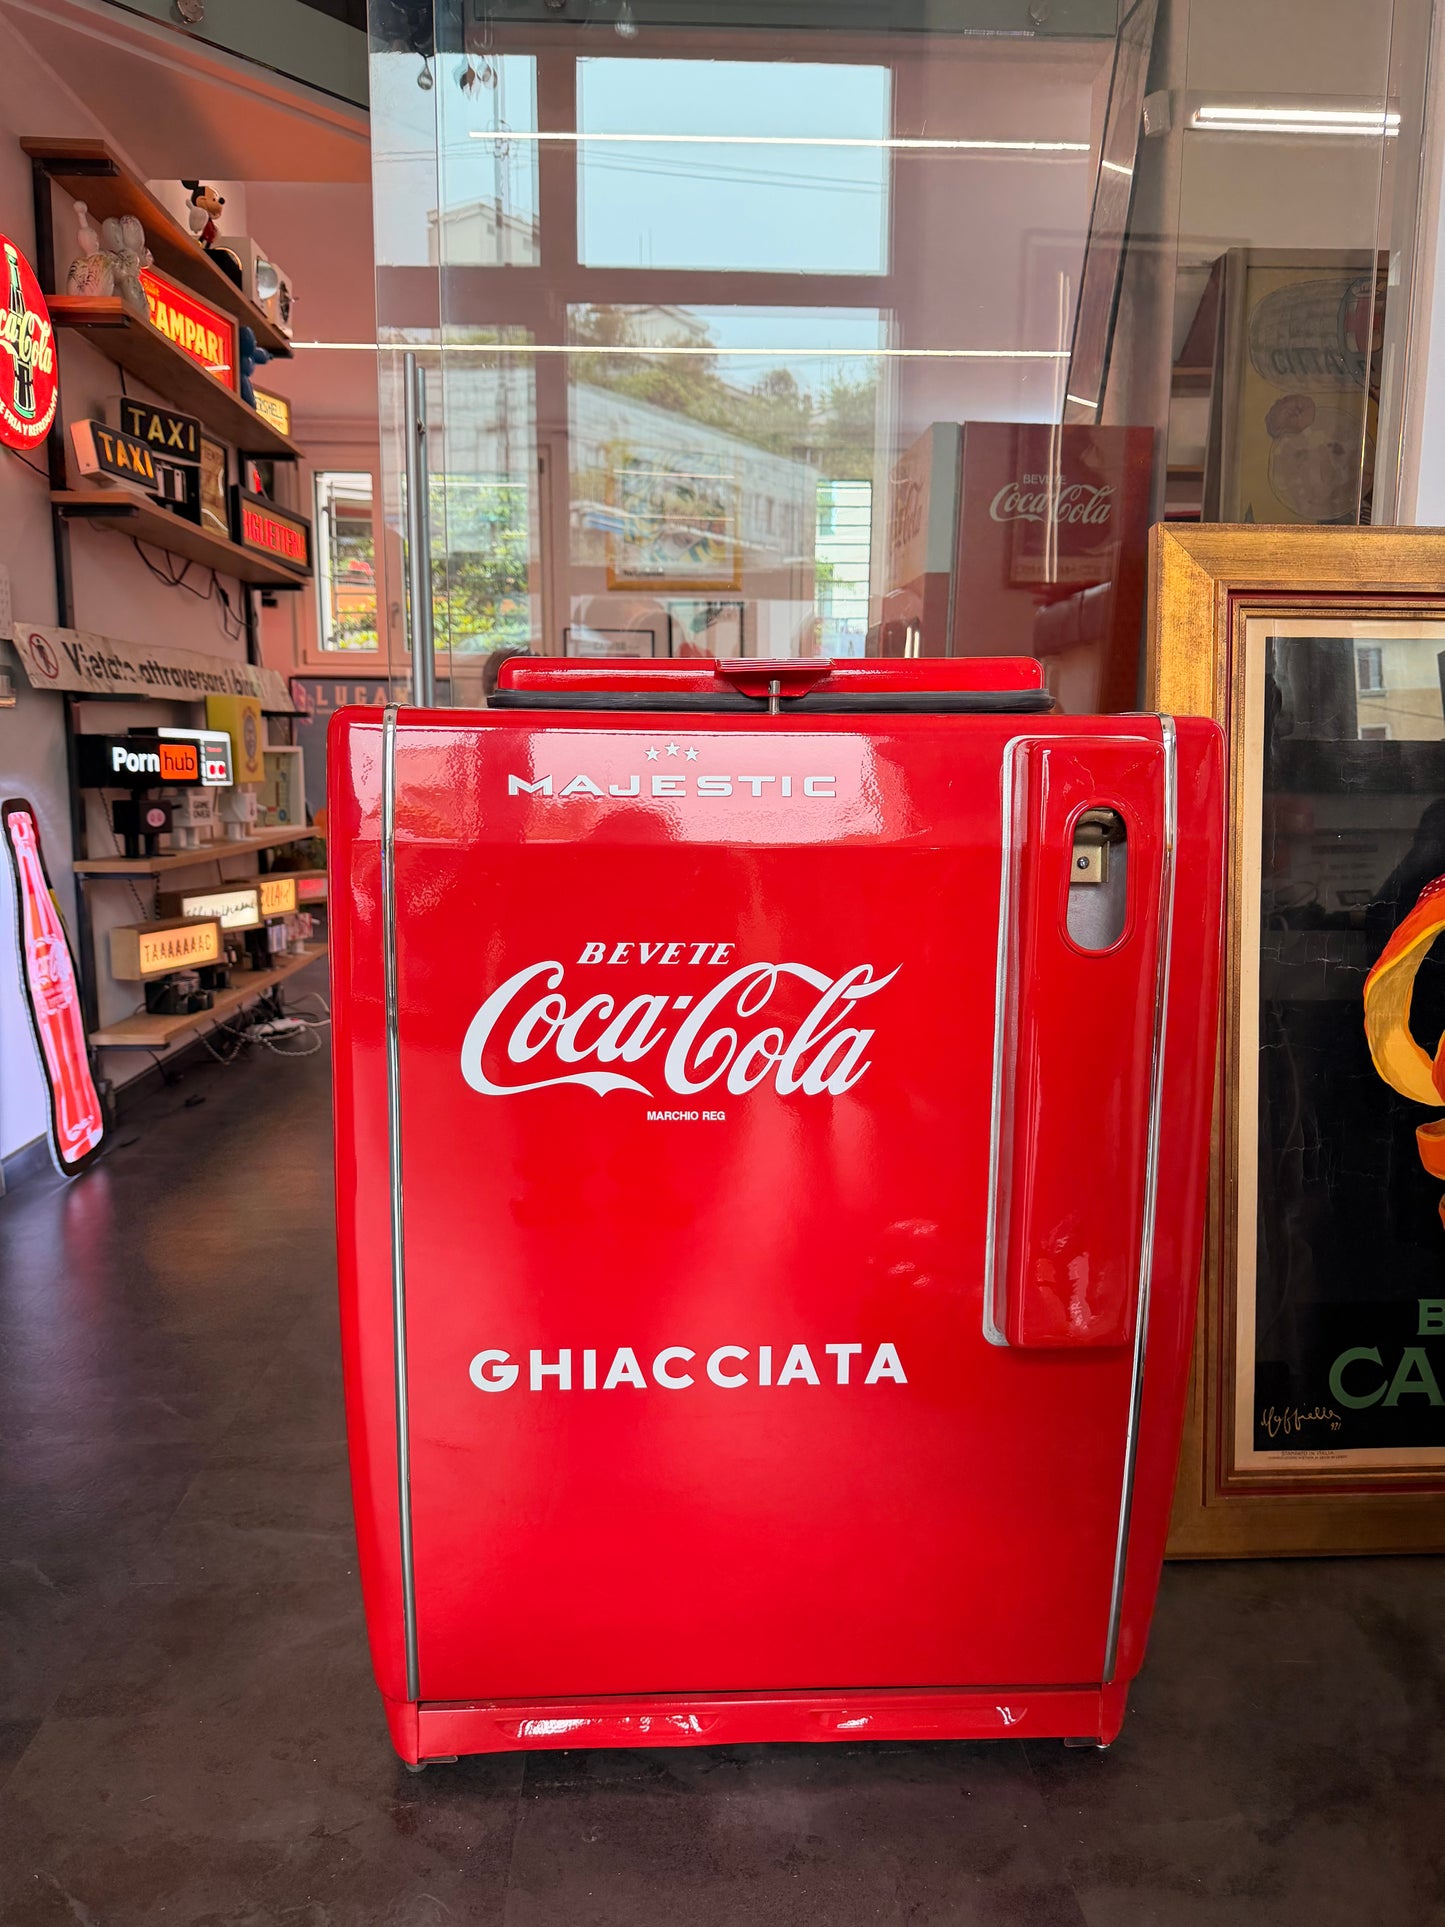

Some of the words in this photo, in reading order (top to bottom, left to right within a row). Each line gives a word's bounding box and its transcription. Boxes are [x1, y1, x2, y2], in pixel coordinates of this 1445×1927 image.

[146, 295, 224, 366] CAMPARI
[127, 407, 195, 453] TAXI
[98, 431, 154, 480] TAXI
[507, 774, 837, 798] MAJESTIC
[577, 942, 736, 965] BEVETE
[460, 960, 903, 1098] Coca-Cola
[646, 1110, 699, 1121] MARCHIO
[702, 1110, 726, 1121] REG
[469, 1342, 908, 1393] GHIACCIATA
